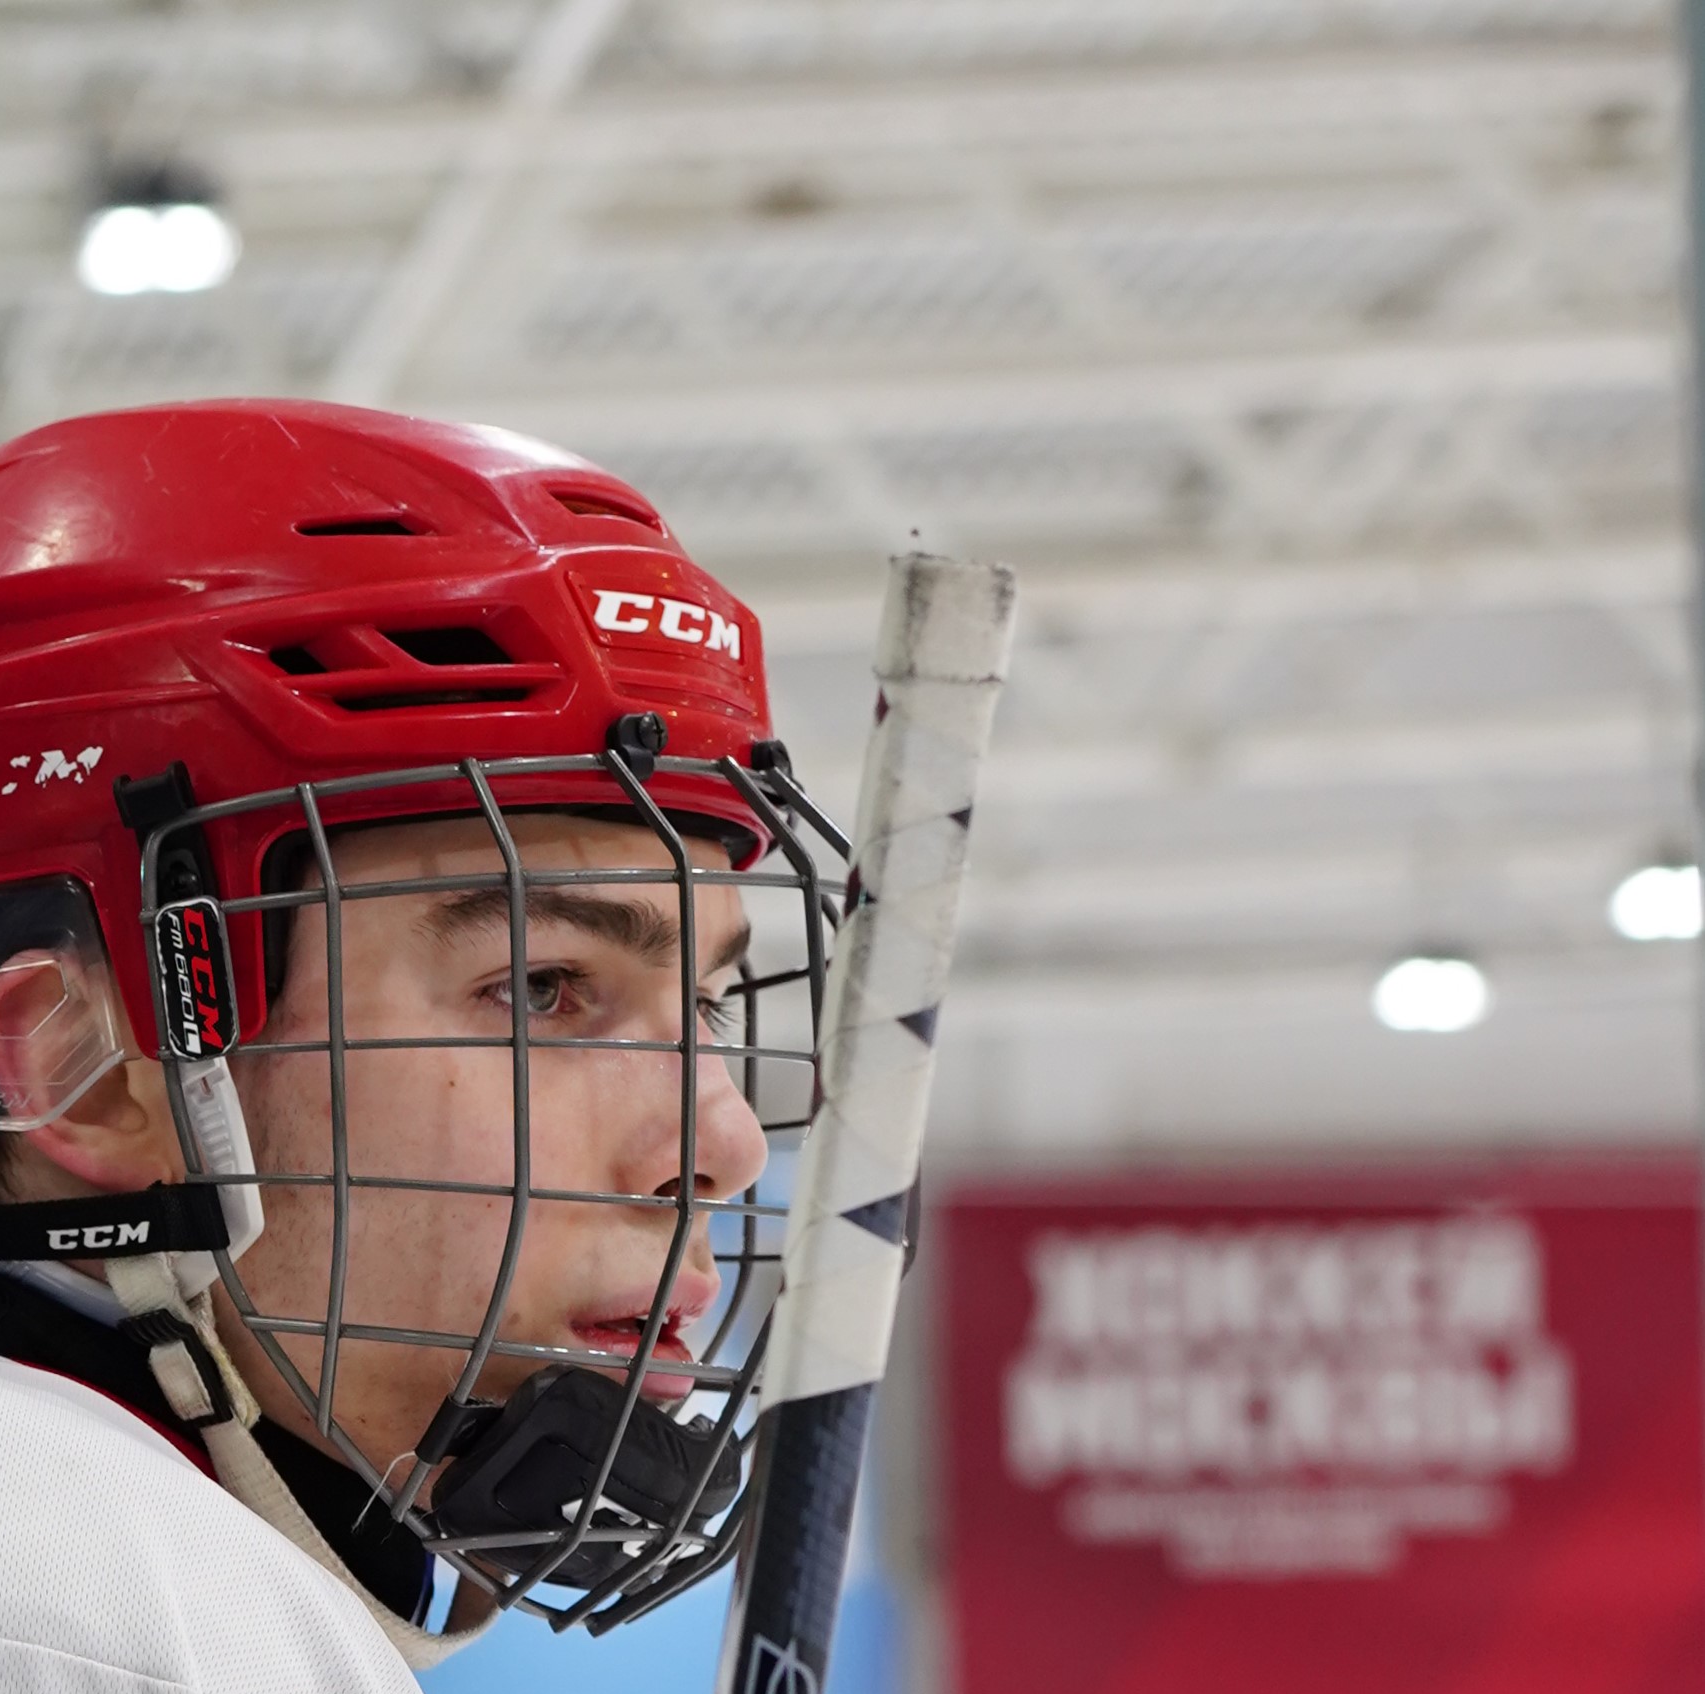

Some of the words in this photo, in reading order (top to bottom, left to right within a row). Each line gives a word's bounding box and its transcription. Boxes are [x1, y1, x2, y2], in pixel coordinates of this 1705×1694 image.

[592, 589, 741, 660] CCM
[183, 907, 224, 1049] CCM
[46, 1220, 151, 1251] CCM
